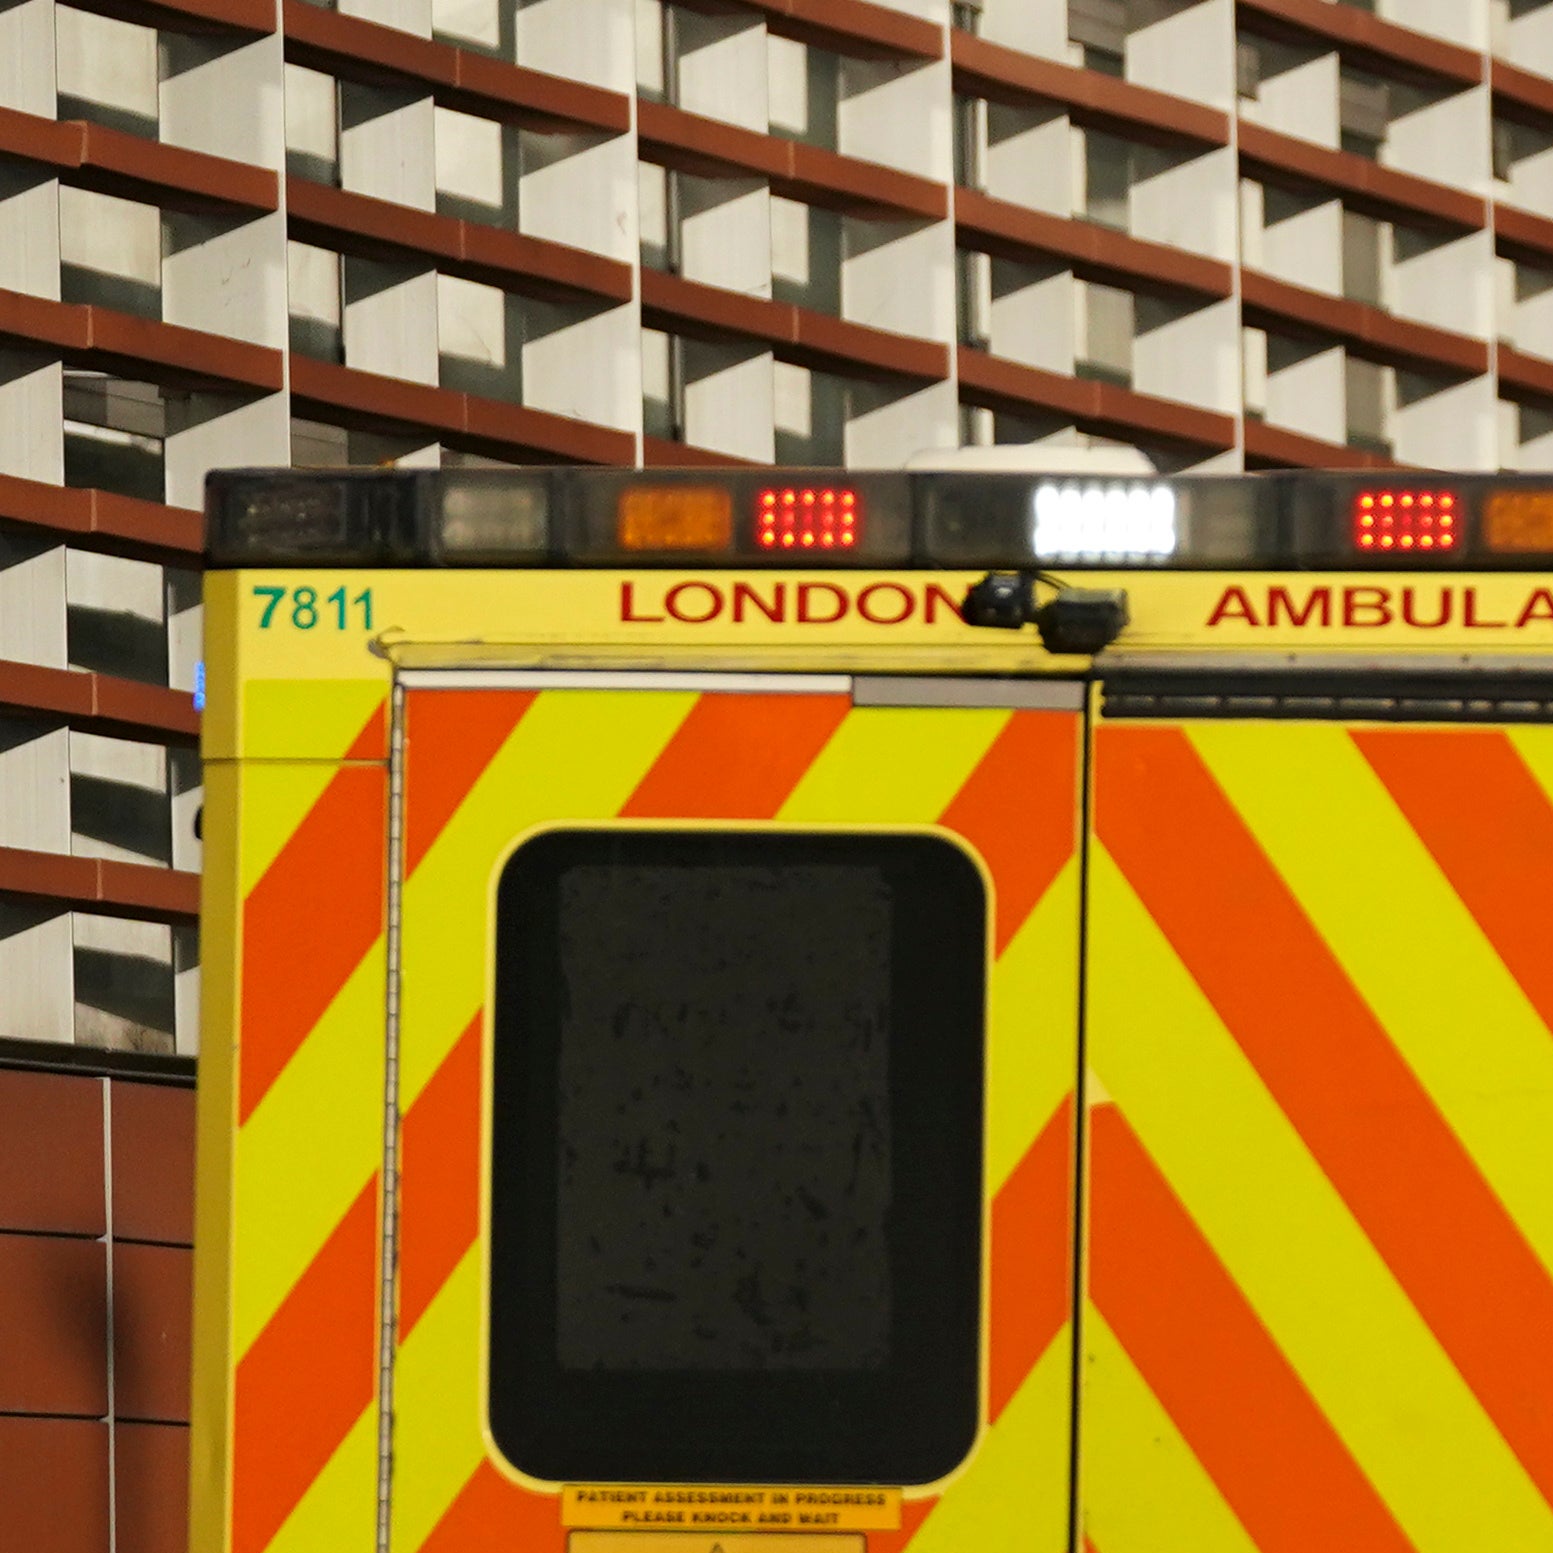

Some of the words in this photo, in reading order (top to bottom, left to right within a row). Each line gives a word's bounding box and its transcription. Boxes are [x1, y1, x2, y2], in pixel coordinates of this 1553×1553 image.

[252, 586, 374, 631] 7811
[619, 581, 970, 625] LONDON
[577, 1490, 647, 1503] PATIENT
[655, 1491, 766, 1504] ASSESSMENT
[773, 1492, 789, 1504] IN
[795, 1492, 886, 1506] PROGRESS
[622, 1511, 684, 1523] PLEASE
[692, 1511, 750, 1524] KNOCK
[758, 1511, 792, 1524] AND
[799, 1512, 840, 1525] WAIT
